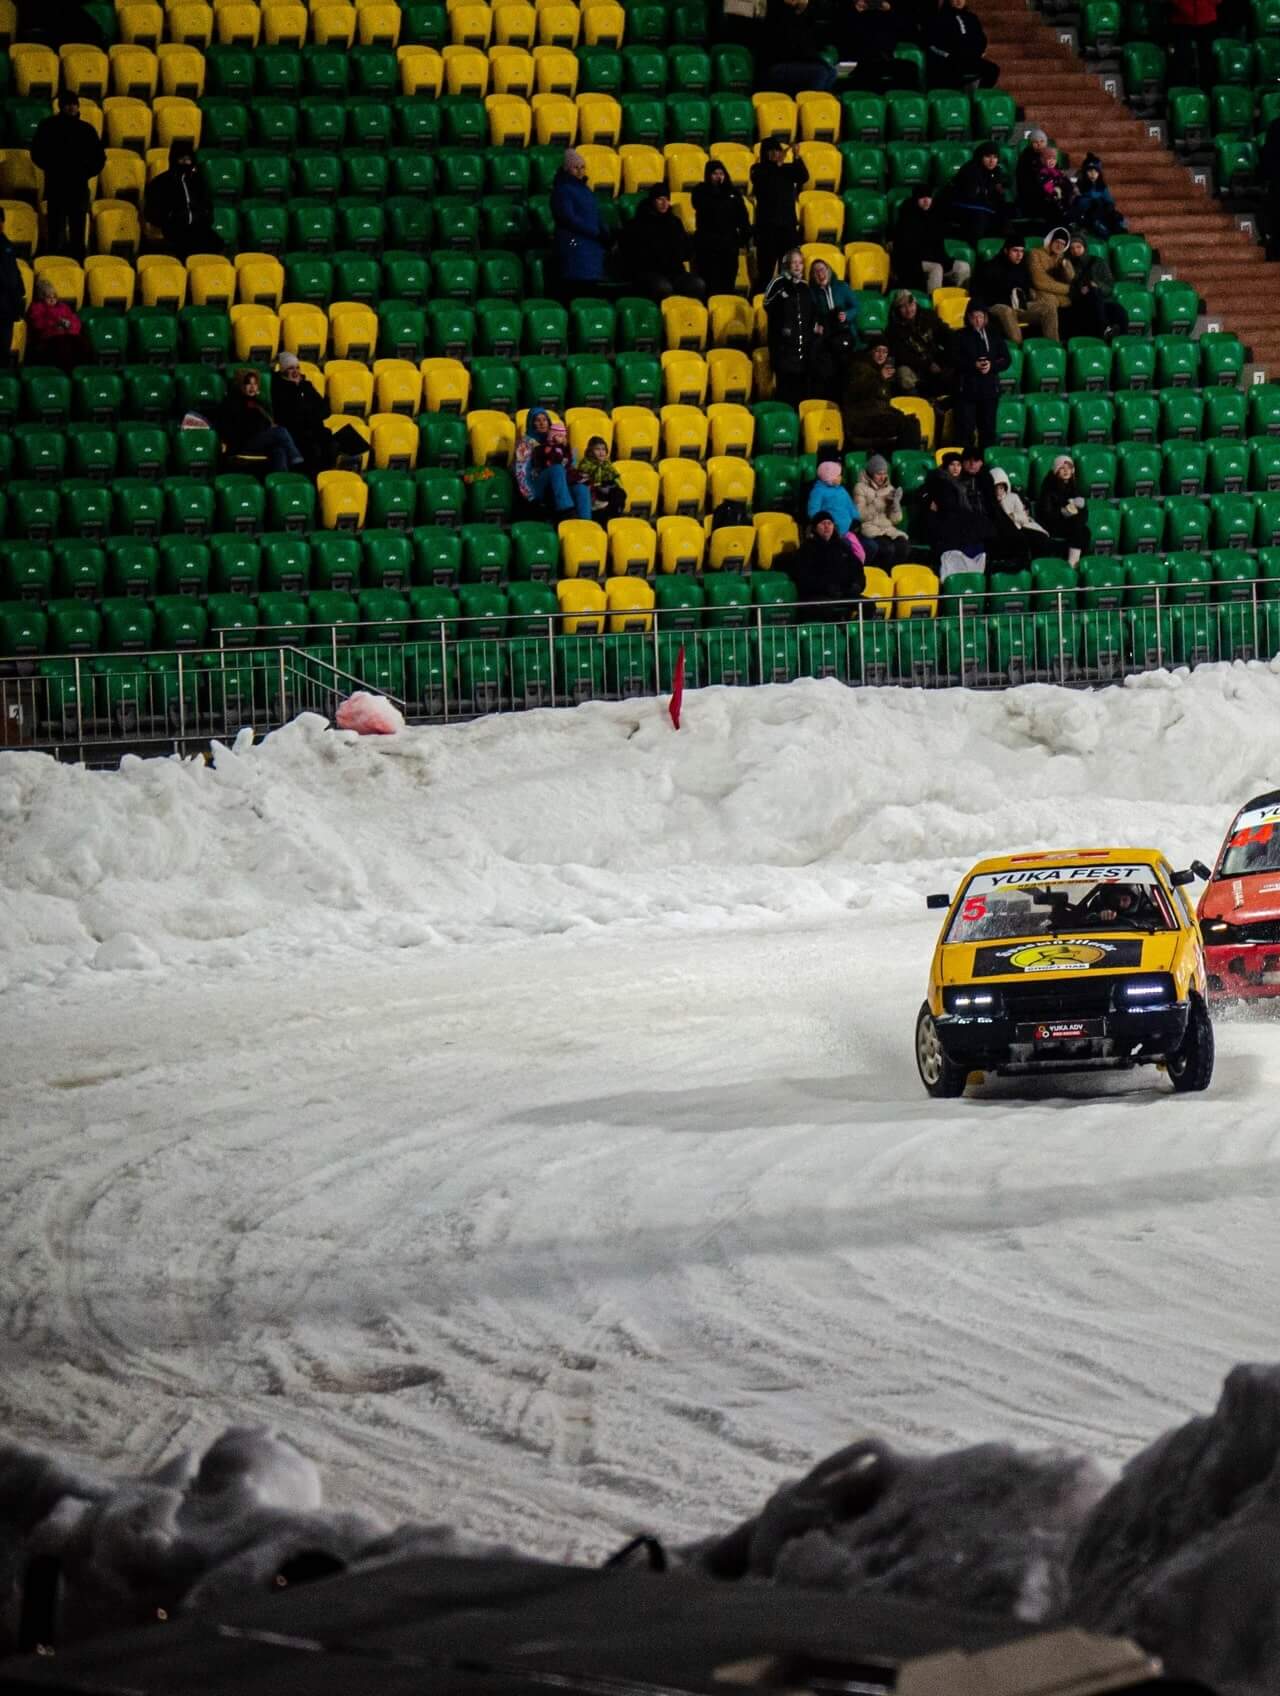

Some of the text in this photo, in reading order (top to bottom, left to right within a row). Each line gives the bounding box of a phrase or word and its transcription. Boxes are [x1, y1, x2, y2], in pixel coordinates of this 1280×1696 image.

[991, 870, 1062, 886] YUKA
[1071, 867, 1141, 879] FEST
[962, 895, 988, 922] 5
